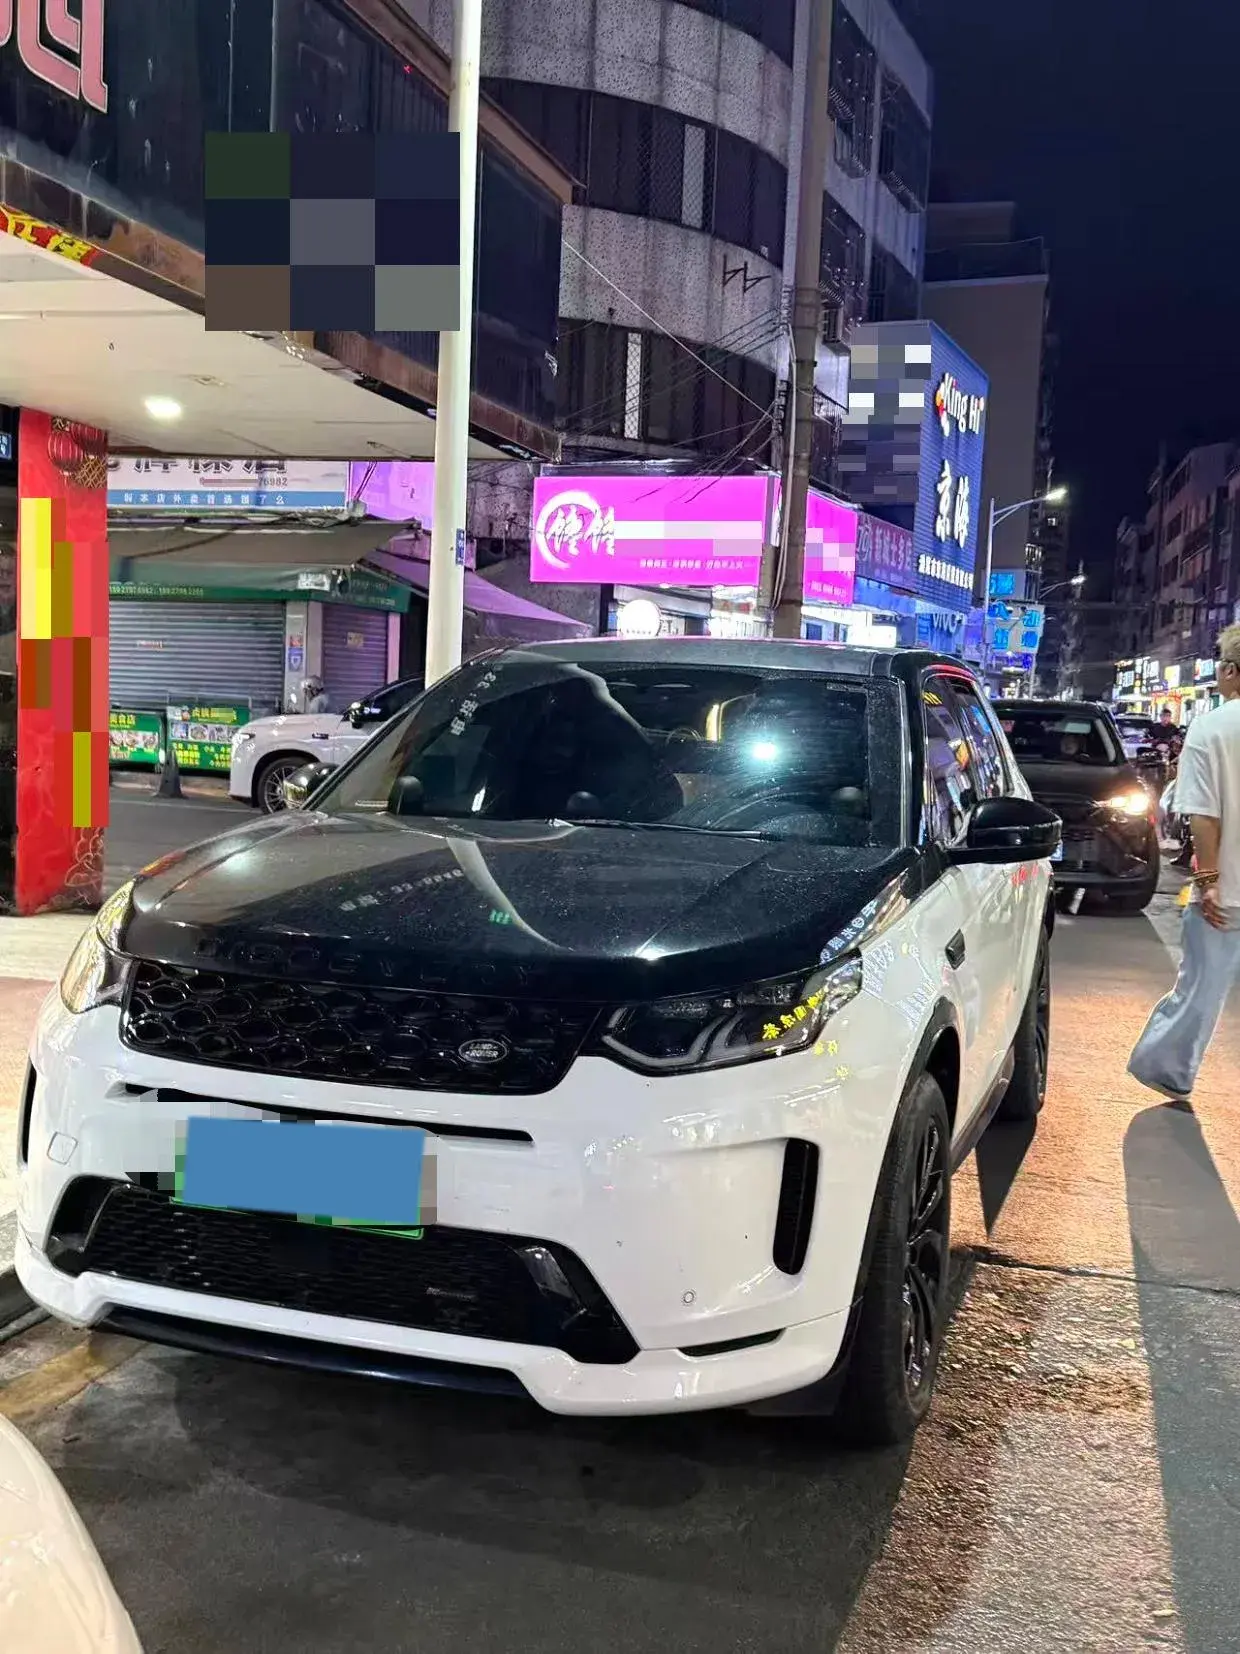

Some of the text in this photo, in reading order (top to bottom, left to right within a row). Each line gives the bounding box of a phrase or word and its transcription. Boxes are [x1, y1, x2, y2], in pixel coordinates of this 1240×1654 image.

[944, 372, 984, 435] King Hi
[469, 1042, 493, 1051] LAND
[470, 1049, 499, 1058] ROVER
